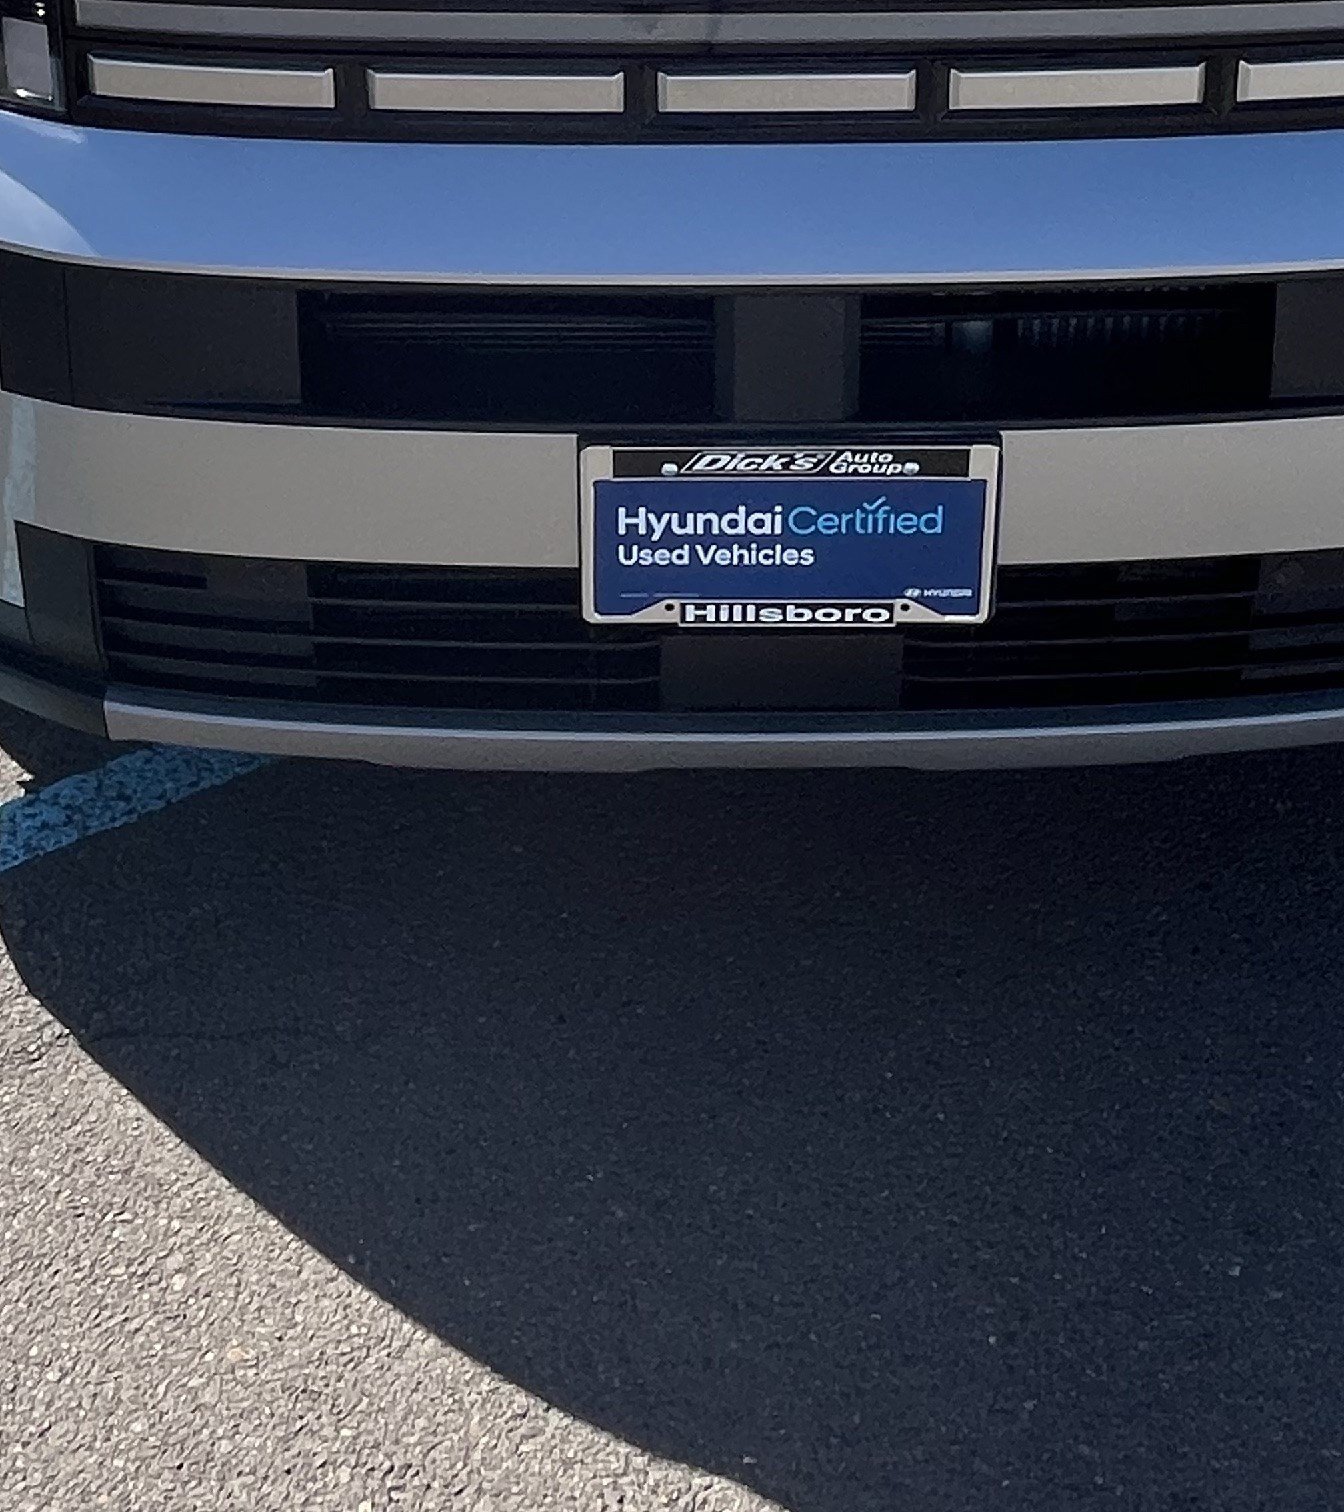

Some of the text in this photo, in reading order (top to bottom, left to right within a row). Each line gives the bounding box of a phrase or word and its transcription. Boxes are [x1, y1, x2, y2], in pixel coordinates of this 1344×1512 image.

[692, 452, 818, 471] Dick's
[835, 451, 894, 464] Auto
[829, 462, 904, 476] Group
[617, 498, 944, 541] Hyundai Certified
[618, 544, 815, 566] Used Vehicles
[684, 603, 891, 622] Hillsboro
